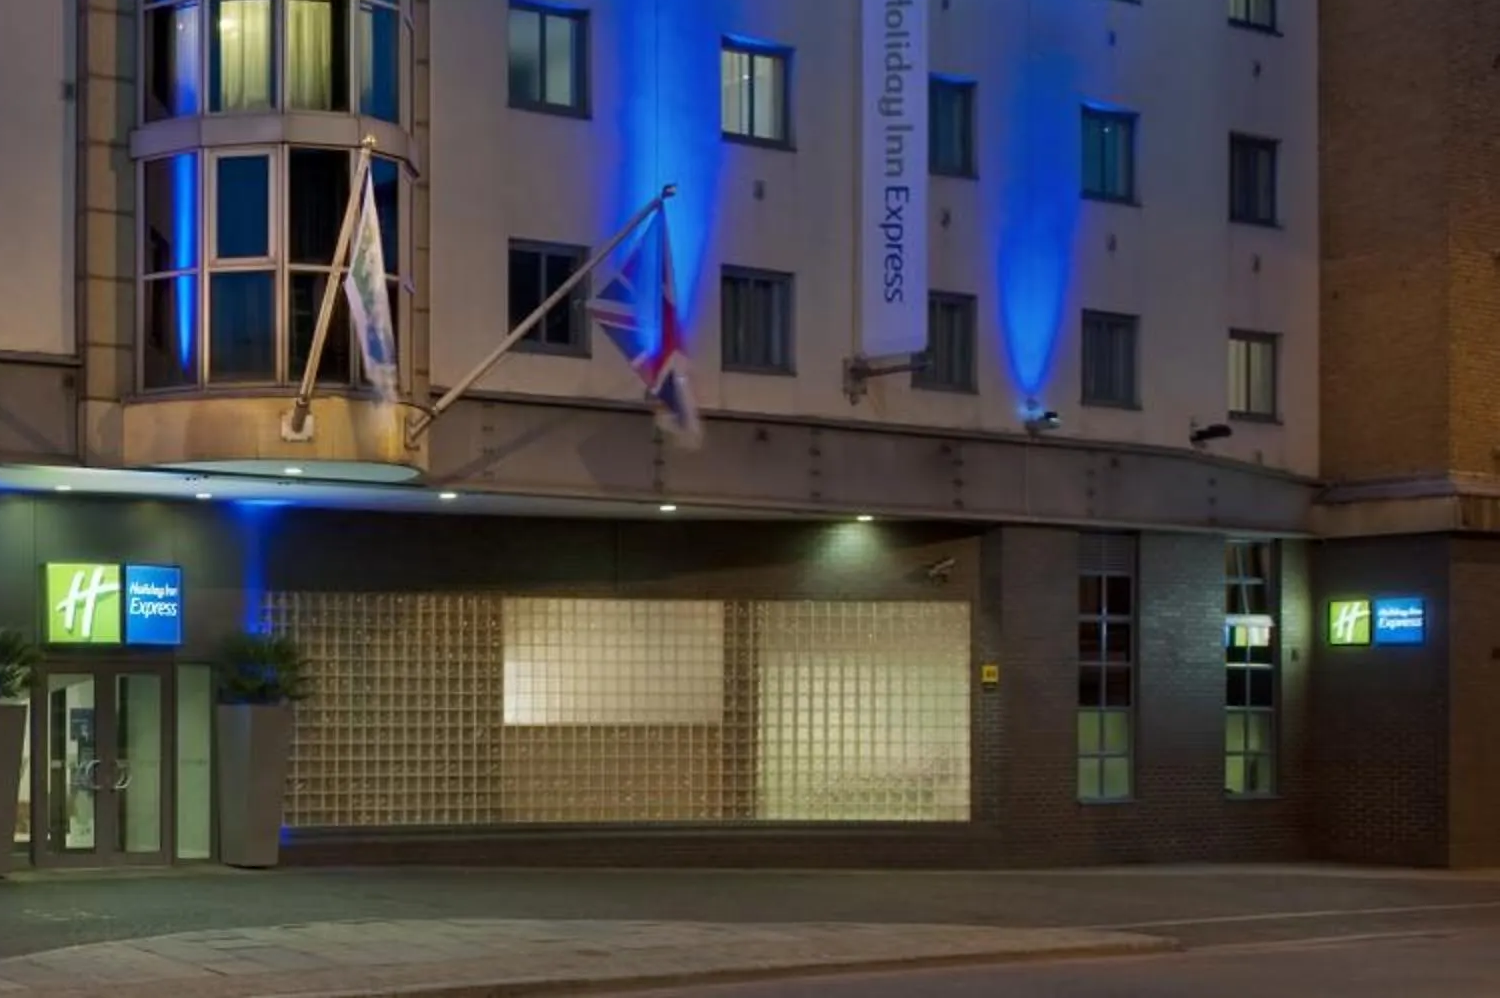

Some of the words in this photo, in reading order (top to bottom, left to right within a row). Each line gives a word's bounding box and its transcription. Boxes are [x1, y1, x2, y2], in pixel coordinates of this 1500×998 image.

[884, 124, 914, 178] Inn
[878, 185, 910, 304] Express
[129, 597, 178, 619] Express
